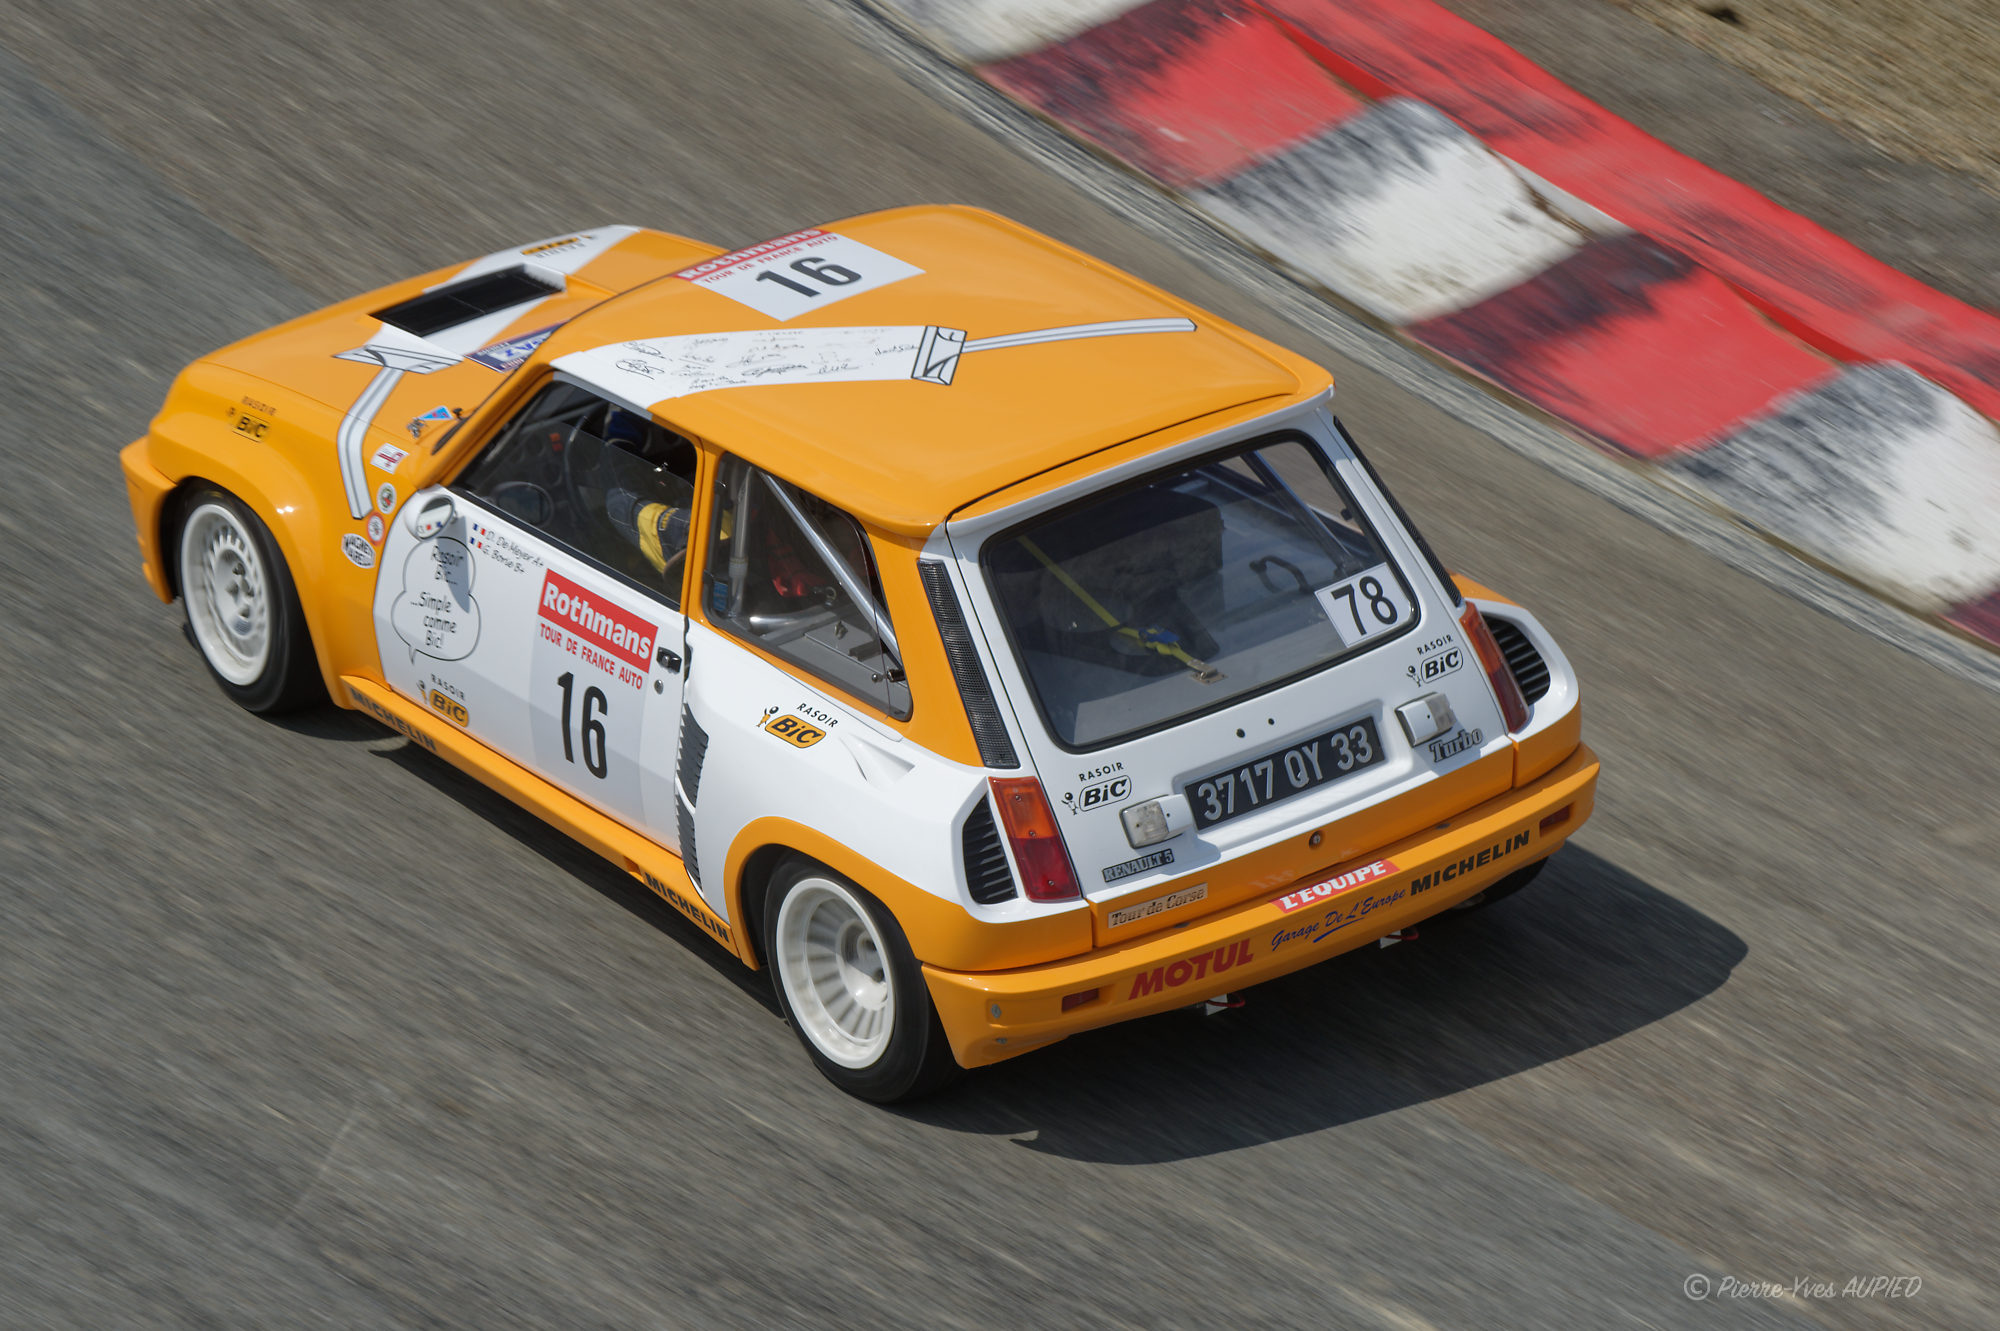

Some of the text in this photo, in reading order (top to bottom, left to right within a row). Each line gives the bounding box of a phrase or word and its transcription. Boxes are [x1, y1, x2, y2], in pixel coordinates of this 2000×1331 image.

[677, 228, 824, 279] Rothmans
[702, 235, 839, 284] TOUR DE FRANCE AUTO
[756, 256, 862, 298] 16
[423, 615, 457, 634] comme
[543, 581, 651, 660] Rothmans
[1330, 575, 1398, 636] 78
[540, 622, 643, 690] TOUR DE FRANCE AUTO
[1416, 634, 1453, 655] RASOIR
[431, 673, 465, 700] RASOIR
[350, 687, 437, 752] MICHELIN
[557, 671, 608, 780] 16
[796, 702, 839, 728] RASOIR
[1428, 728, 1483, 763] Turbo
[1078, 761, 1124, 782] RASOIR
[1197, 725, 1373, 821] 3717 QY 33
[1104, 850, 1174, 881] RENAULT 5
[1279, 861, 1387, 909] L'EQUIPE
[1410, 829, 1530, 896] MICHELIN
[644, 871, 730, 944] MICHELIN
[1111, 888, 1205, 926] Tour de Corse
[1271, 888, 1406, 952] Garage De L'Europe
[1128, 937, 1254, 1000] MOTUL
